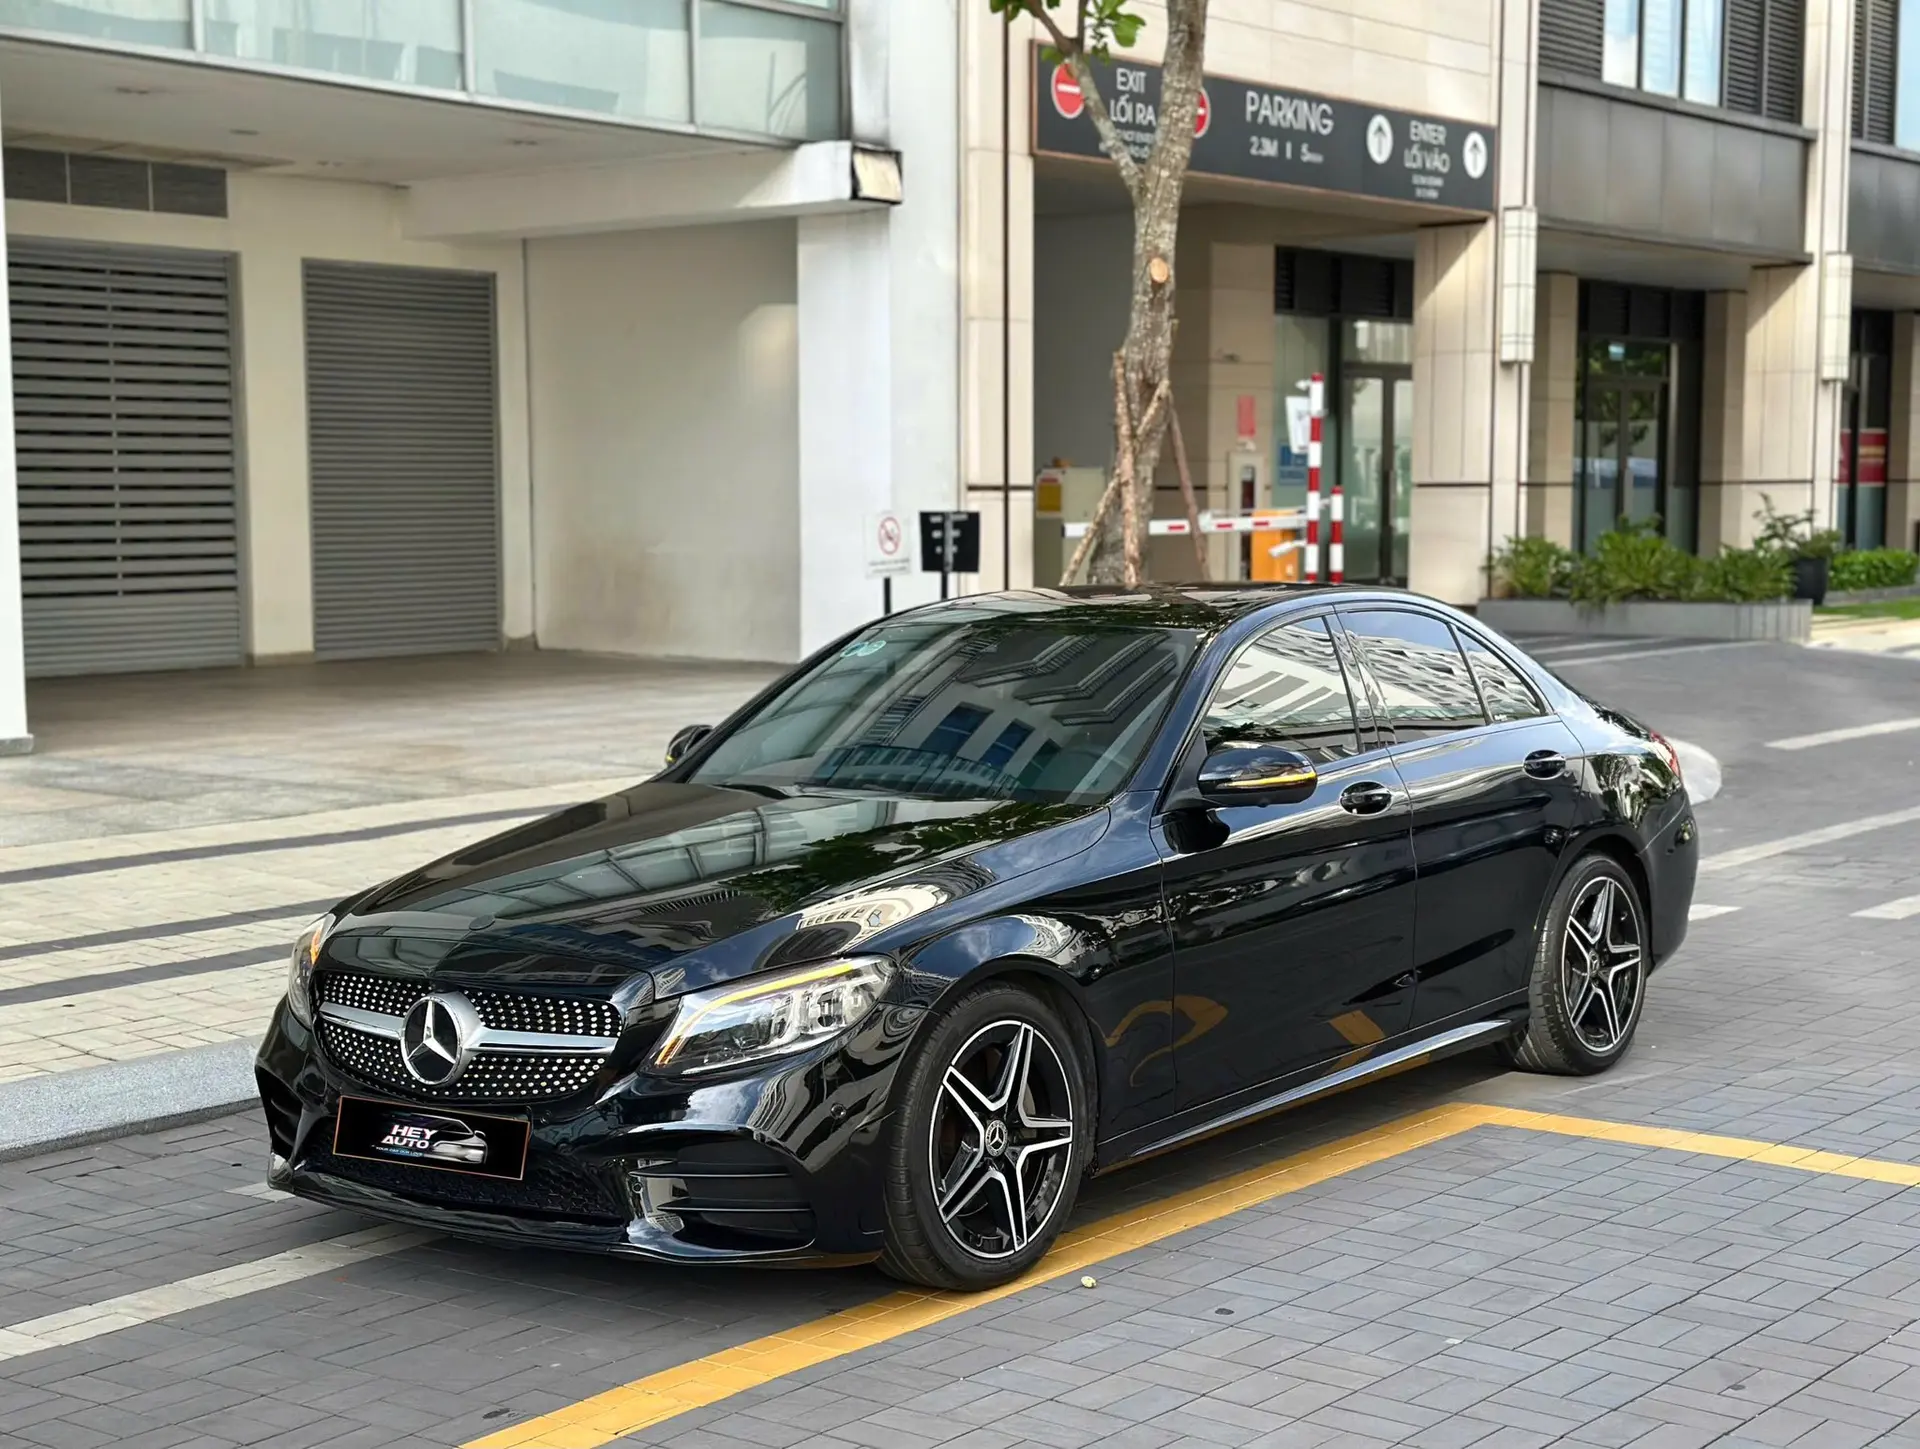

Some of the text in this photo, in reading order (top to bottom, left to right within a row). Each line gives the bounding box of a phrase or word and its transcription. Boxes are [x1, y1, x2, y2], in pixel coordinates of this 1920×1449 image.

[1116, 67, 1147, 94] EXIT
[1135, 102, 1157, 127] RA
[1246, 89, 1334, 136] PARKING
[1410, 119, 1447, 147] ENTER
[381, 1135, 429, 1149] AUTO
[391, 1124, 438, 1140] HEY
